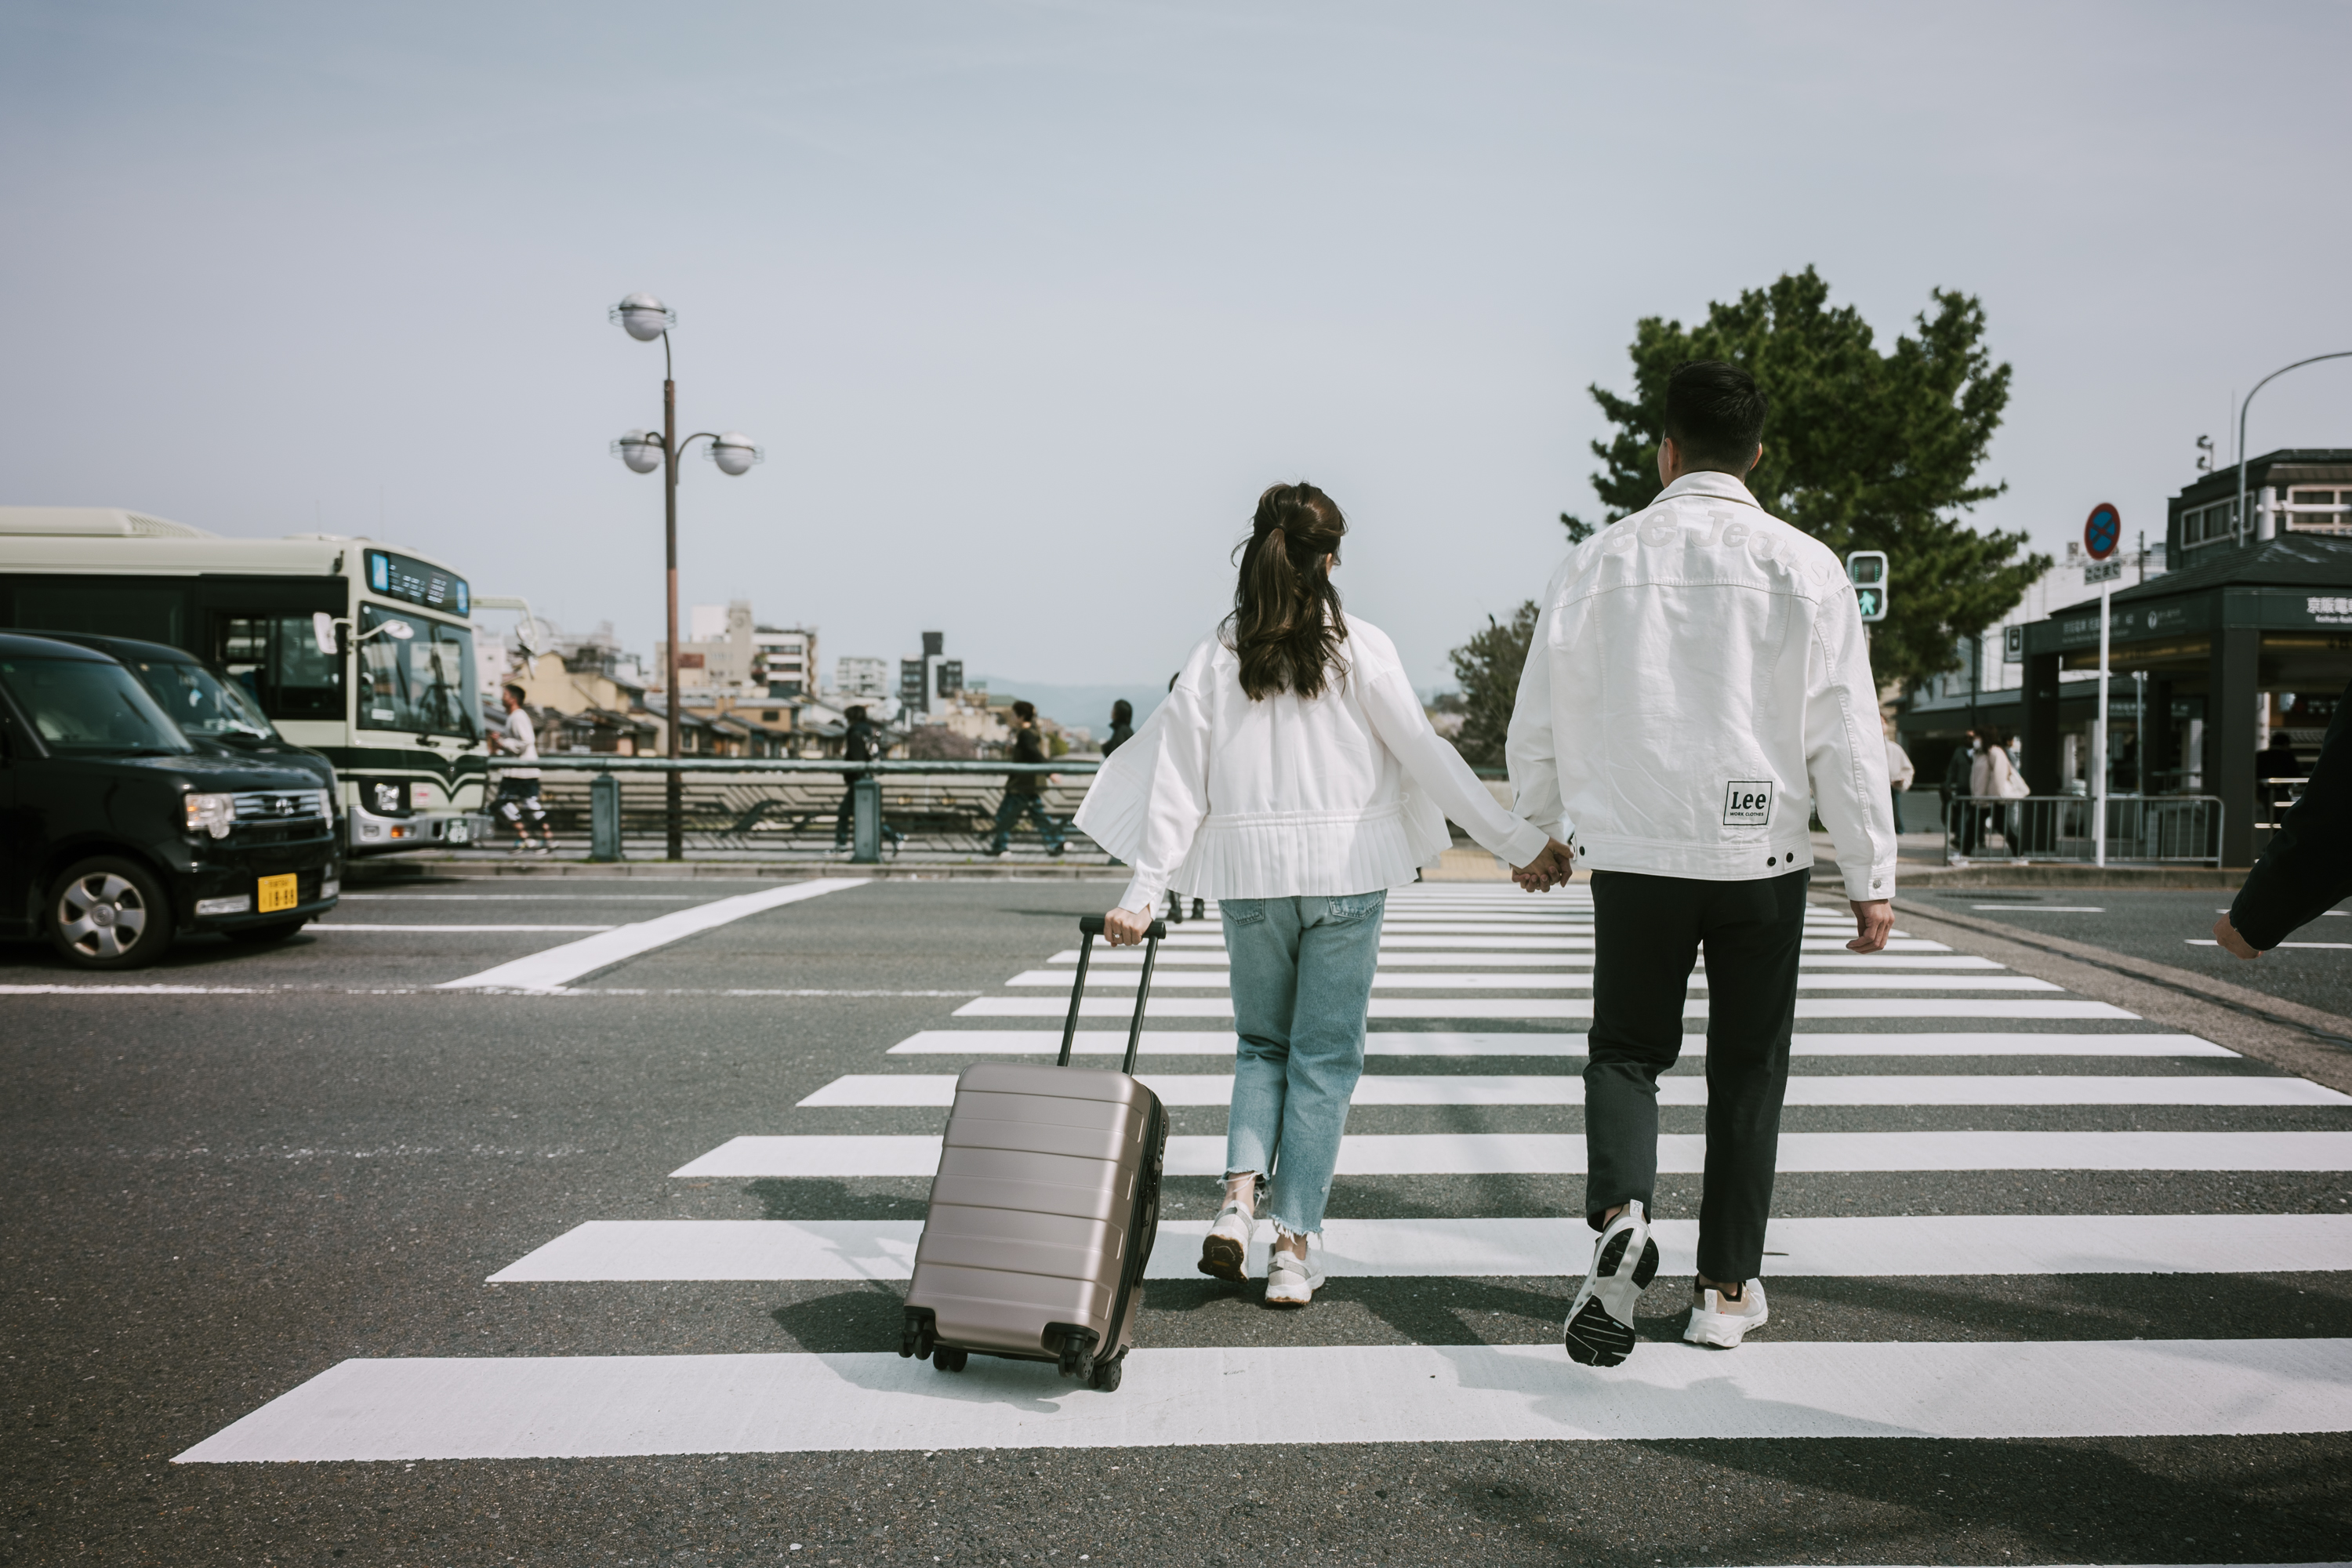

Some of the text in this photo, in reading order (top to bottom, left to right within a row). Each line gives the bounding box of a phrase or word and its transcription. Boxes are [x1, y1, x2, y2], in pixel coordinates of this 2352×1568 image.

[1565, 508, 1831, 589] Lee Jeans
[1730, 791, 1766, 810] Lee
